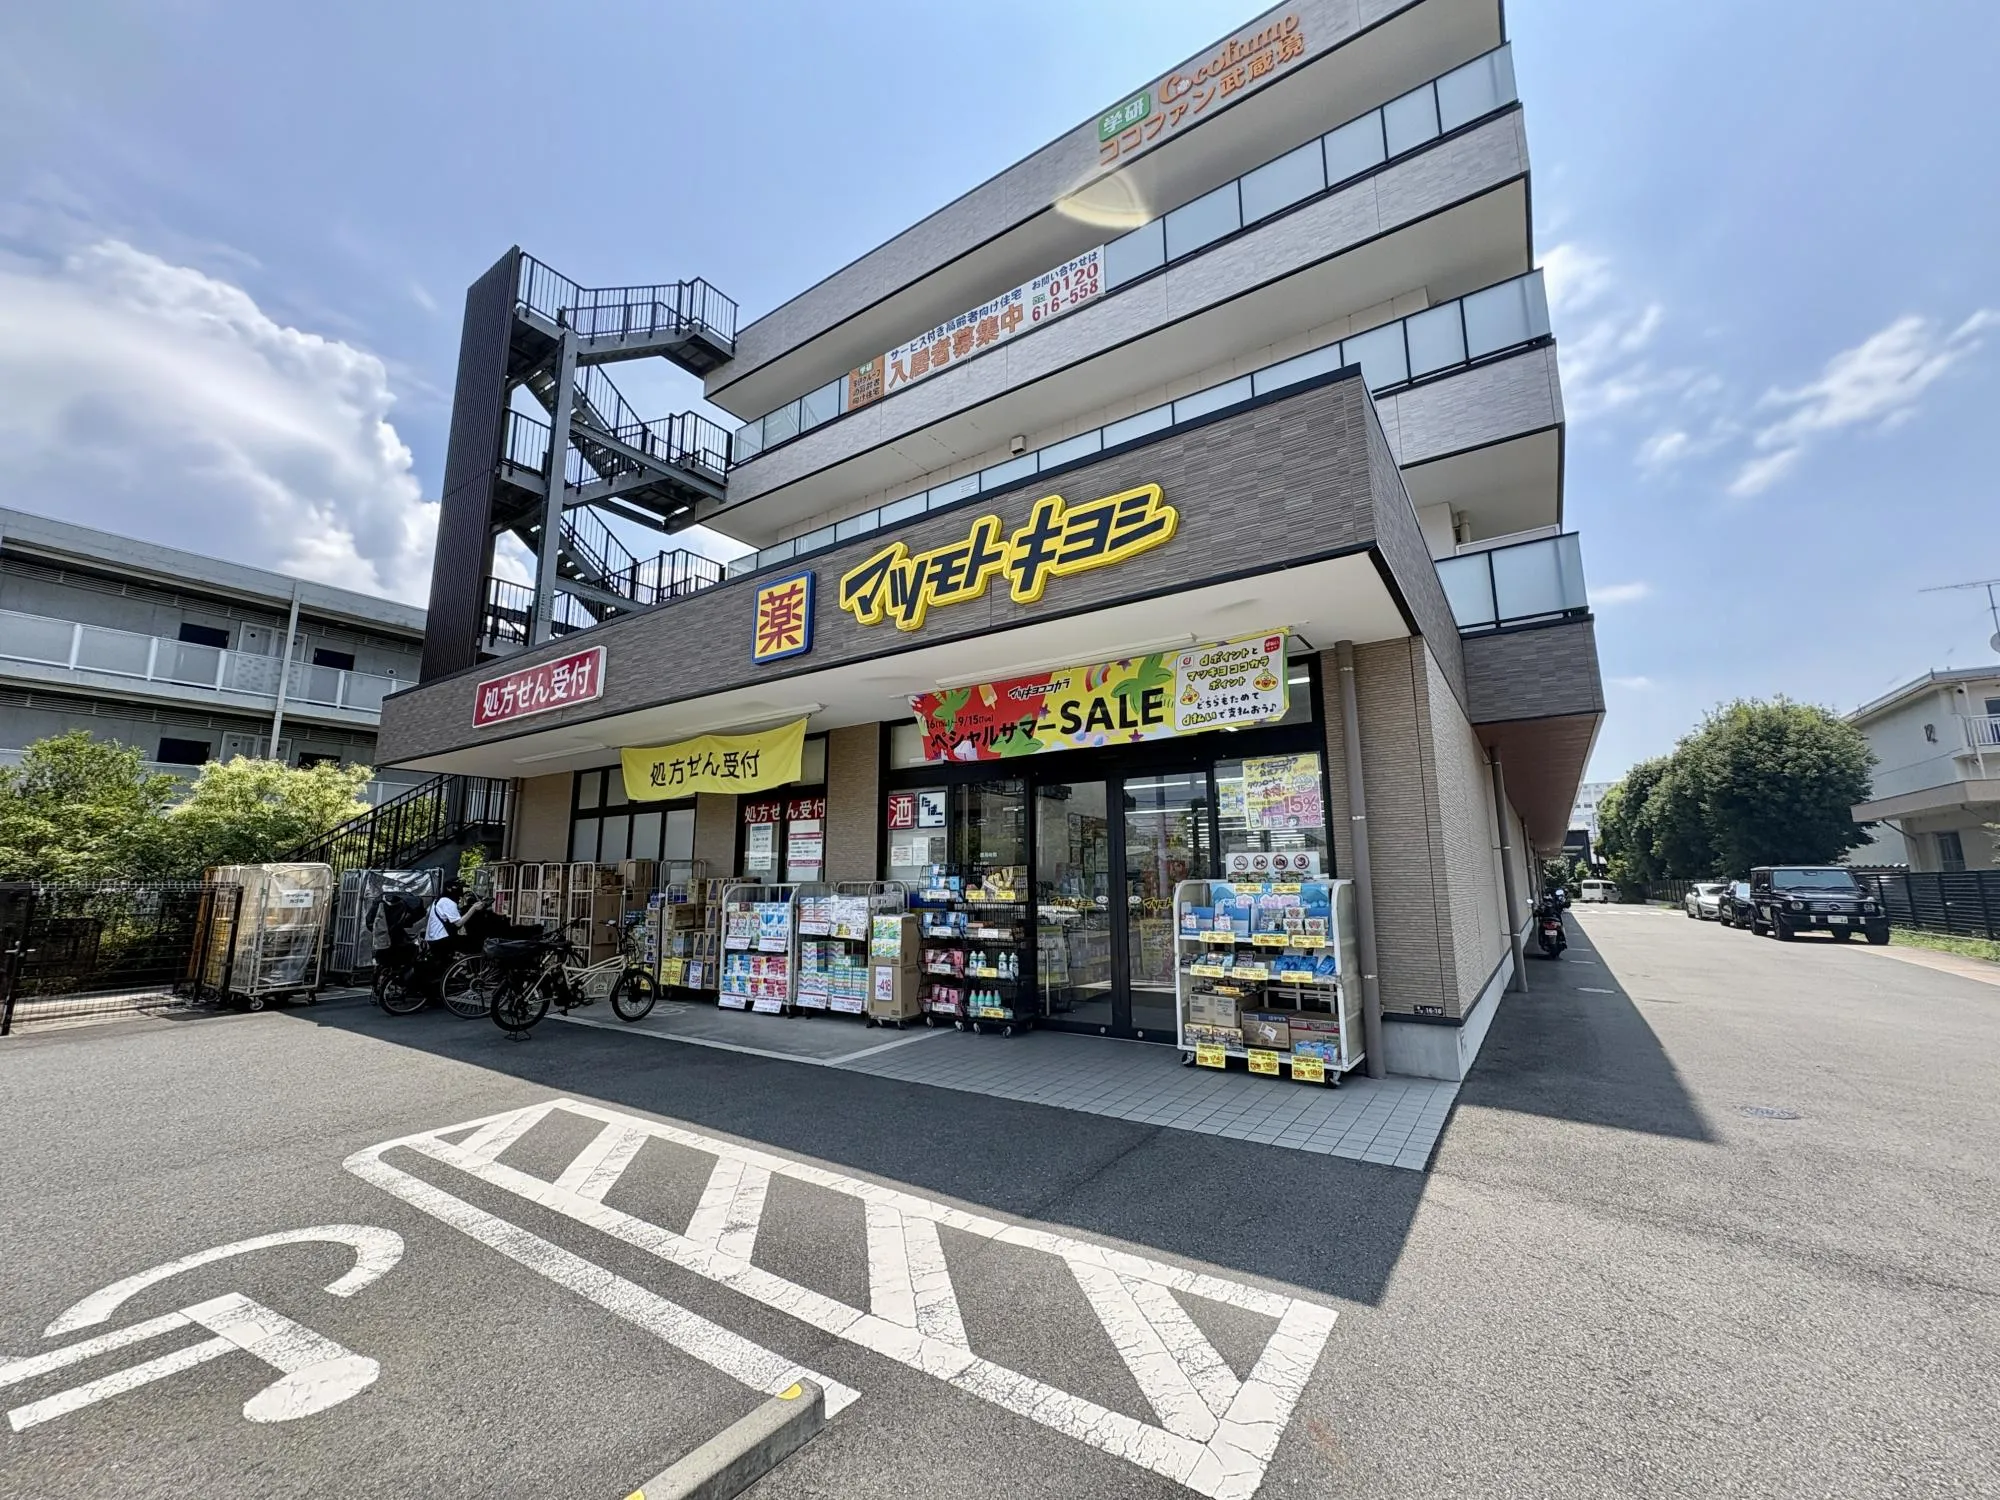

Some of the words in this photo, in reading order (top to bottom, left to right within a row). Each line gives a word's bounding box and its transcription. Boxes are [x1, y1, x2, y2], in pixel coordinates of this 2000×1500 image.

[1100, 32, 1304, 166] ココファン武蔵境
[1103, 97, 1145, 134] 学研
[1032, 251, 1098, 290] お問い合わせは
[1049, 262, 1098, 297] 0120
[1032, 278, 1098, 322] 616-558
[890, 288, 1022, 361] サービス付き高齢者向け住宅
[888, 303, 1023, 390] 入居者募集中
[842, 487, 1174, 627] マツモトキヨシ
[758, 582, 804, 655] 薬
[1187, 656, 1270, 681] マツキヨココカラ
[1200, 647, 1258, 666] dポイントと
[482, 653, 592, 718] 処方せん受付
[1008, 678, 1071, 701] マツキヨココカラ
[1197, 692, 1260, 709] どちらもためて
[1208, 676, 1246, 690] ポイント
[650, 750, 760, 787] 処方せん受付
[745, 798, 826, 823] 処方せん受付
[890, 797, 911, 826] 酒
[1284, 796, 1318, 813] 15%
